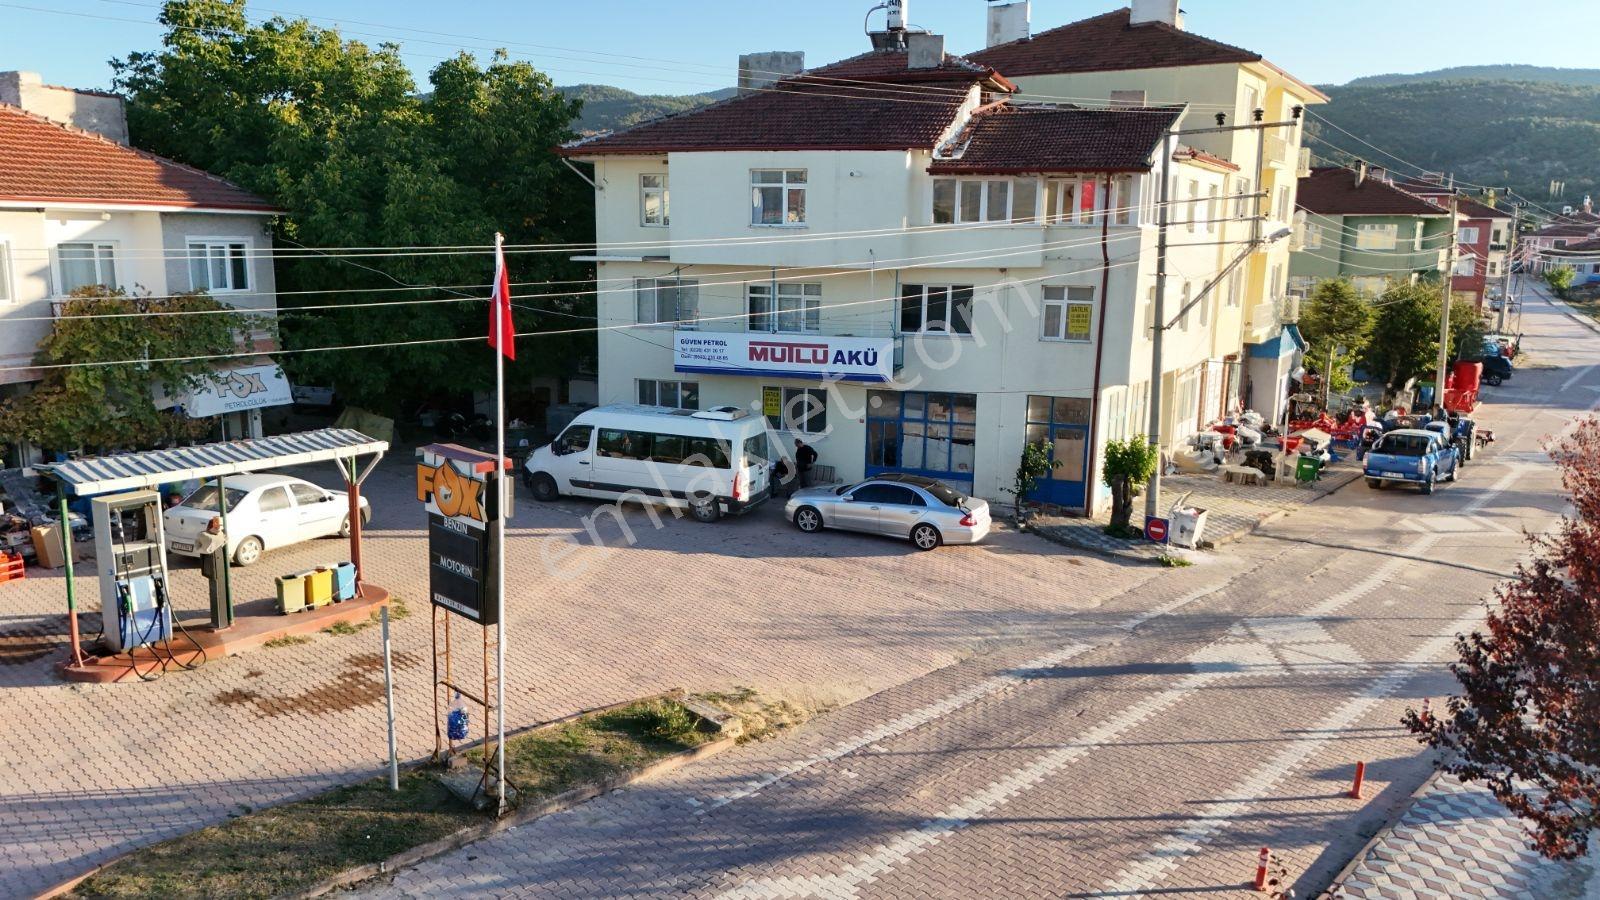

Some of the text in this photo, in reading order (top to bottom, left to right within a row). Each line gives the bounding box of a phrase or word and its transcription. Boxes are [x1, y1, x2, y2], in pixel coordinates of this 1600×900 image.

[748, 341, 878, 366] MUTLU AKÜ
[212, 370, 268, 398] FOX
[416, 458, 485, 523] FOX
